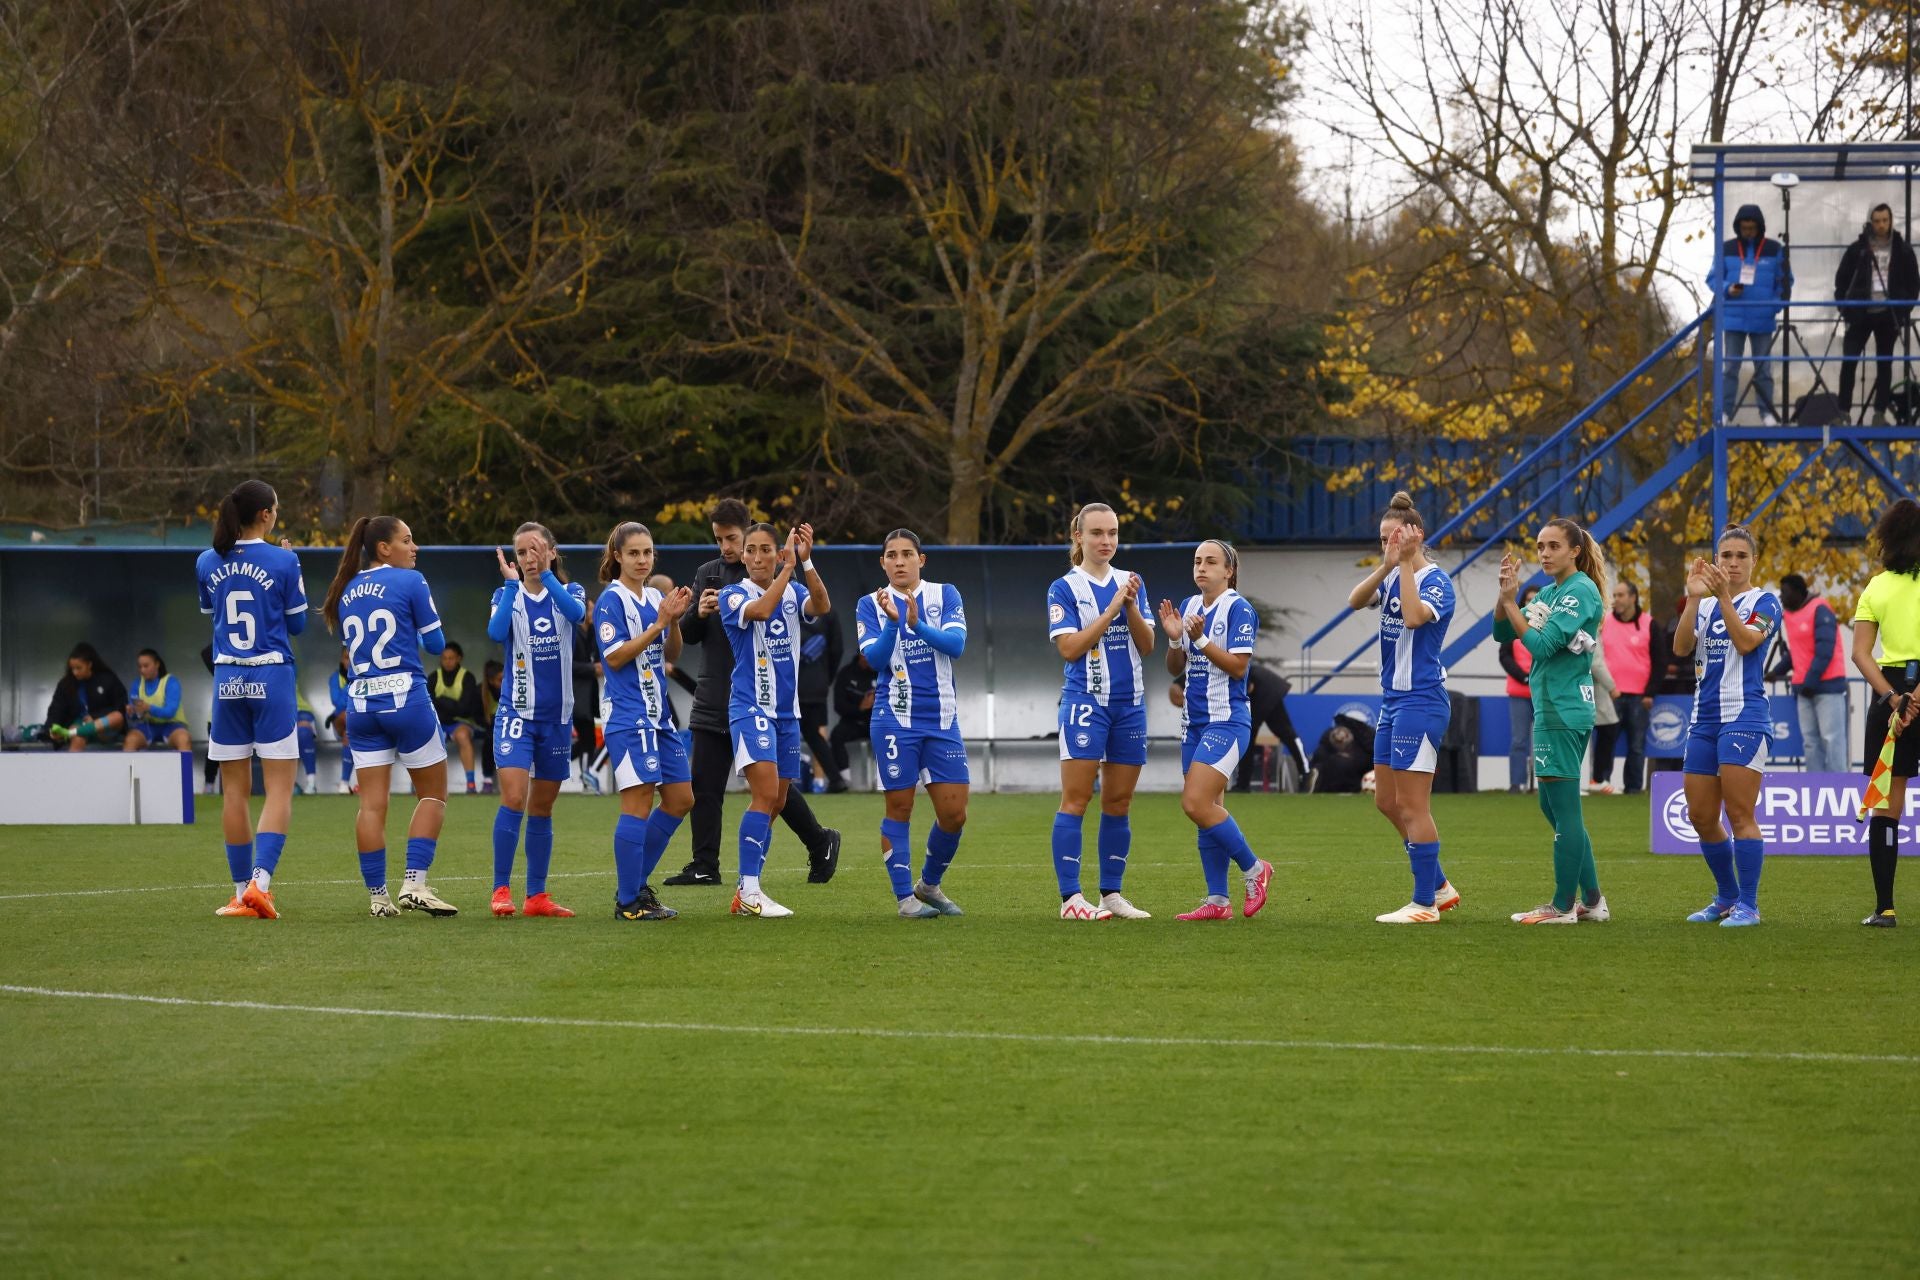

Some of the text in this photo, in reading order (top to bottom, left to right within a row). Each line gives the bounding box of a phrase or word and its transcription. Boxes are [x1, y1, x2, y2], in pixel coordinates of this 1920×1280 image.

[341, 582, 386, 607] RAQUEL
[225, 590, 256, 651] 5
[342, 608, 402, 676] 22
[218, 682, 267, 696] FORONDA
[370, 678, 405, 691] ELEYCO
[1069, 703, 1093, 727] 12
[884, 734, 899, 760] 3
